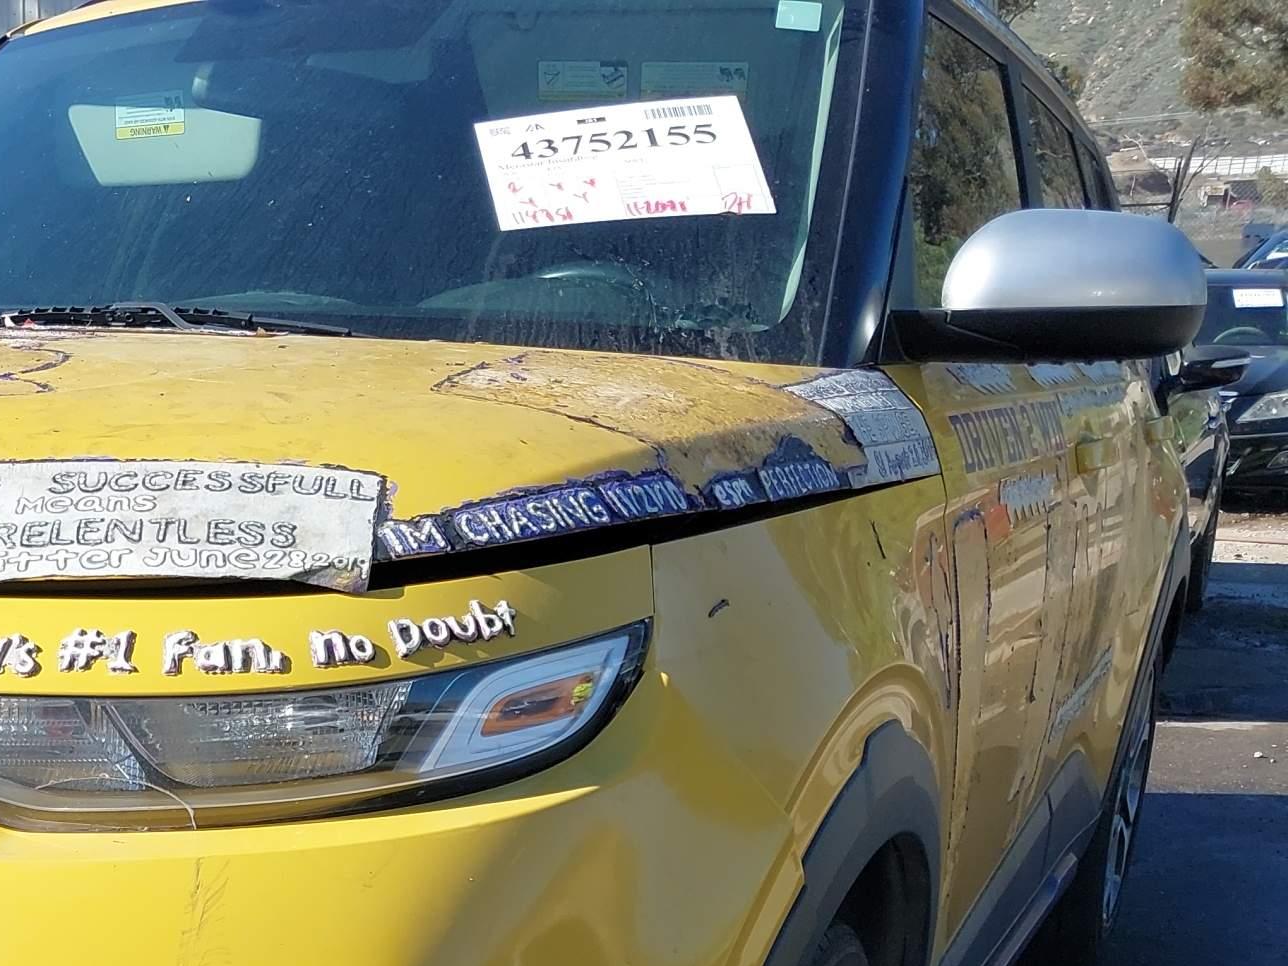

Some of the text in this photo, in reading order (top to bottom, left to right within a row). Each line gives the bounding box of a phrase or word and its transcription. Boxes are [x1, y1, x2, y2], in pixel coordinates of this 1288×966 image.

[511, 123, 717, 160] 43752155
[948, 407, 1028, 474] DRIVEN
[48, 469, 375, 502] SUCCESSFULL
[458, 491, 610, 543] CHASING
[760, 463, 840, 500] PERFECTION
[58, 628, 140, 673] #1
